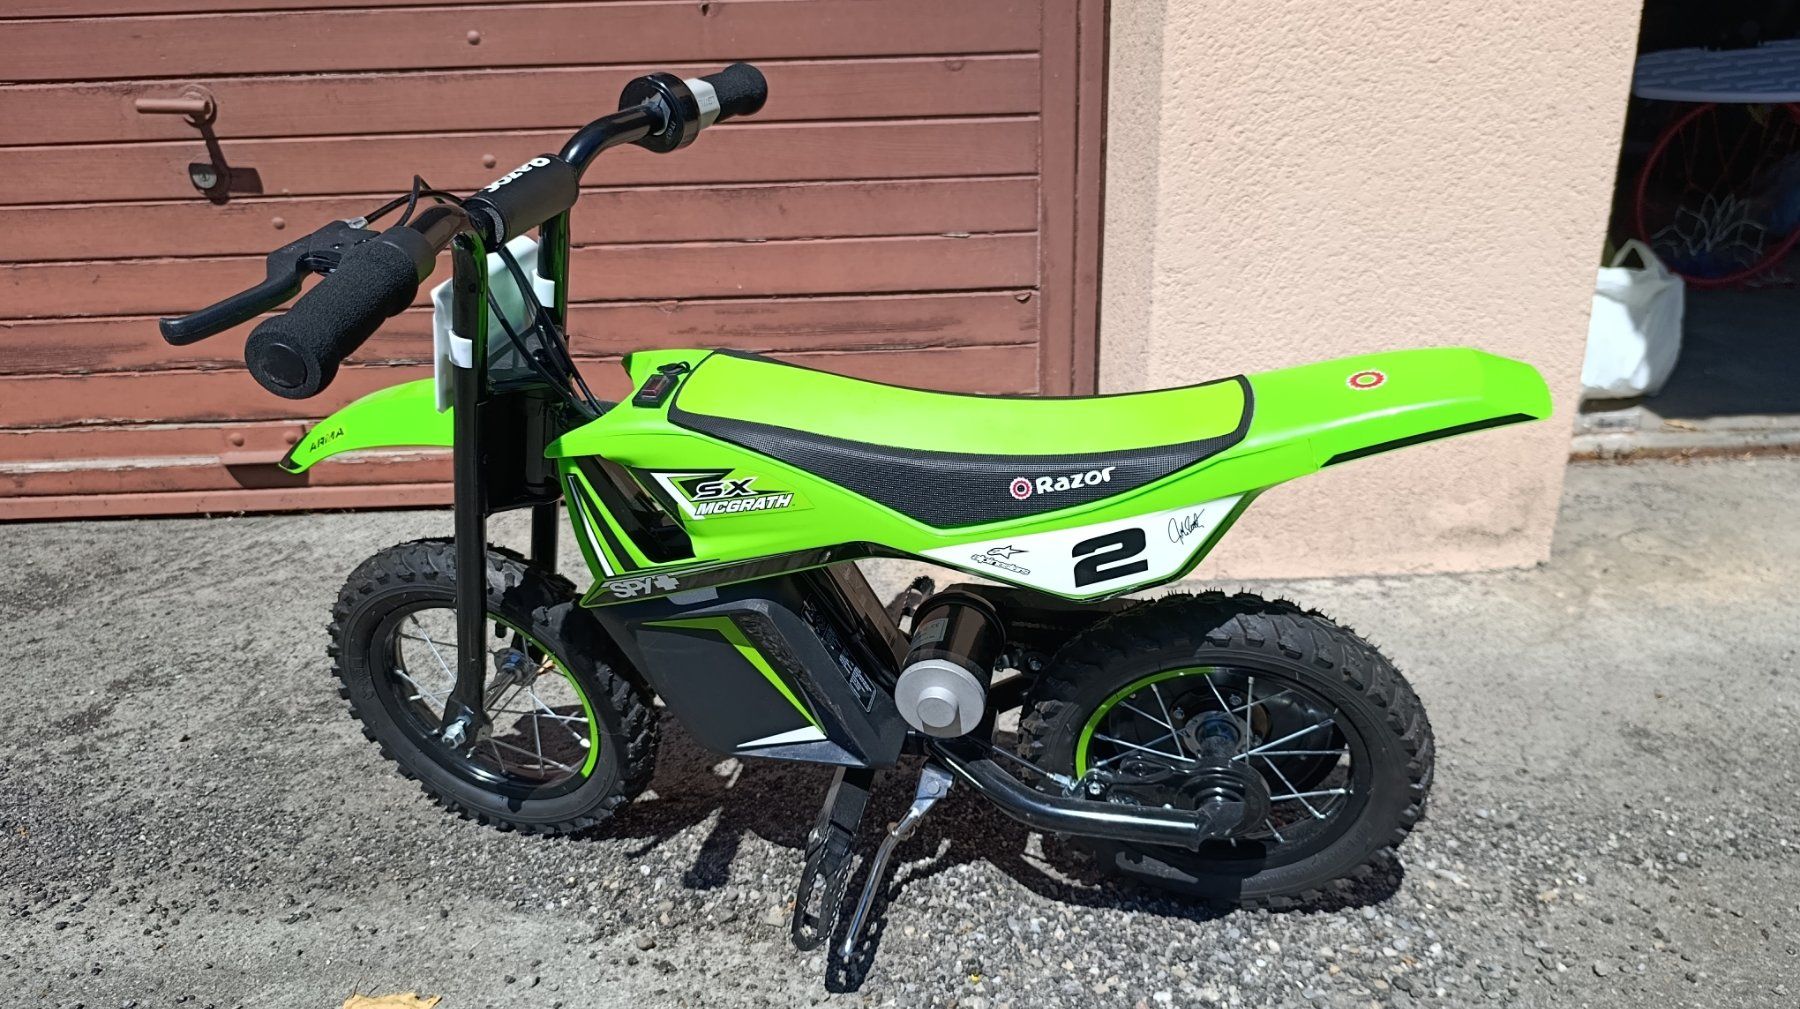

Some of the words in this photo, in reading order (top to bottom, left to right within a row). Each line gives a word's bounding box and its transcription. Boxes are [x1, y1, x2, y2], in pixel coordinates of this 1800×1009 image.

[696, 477, 758, 499] SX
[1036, 467, 1116, 494] Razor
[695, 493, 794, 516] MCGRATH
[1072, 527, 1149, 588] 2
